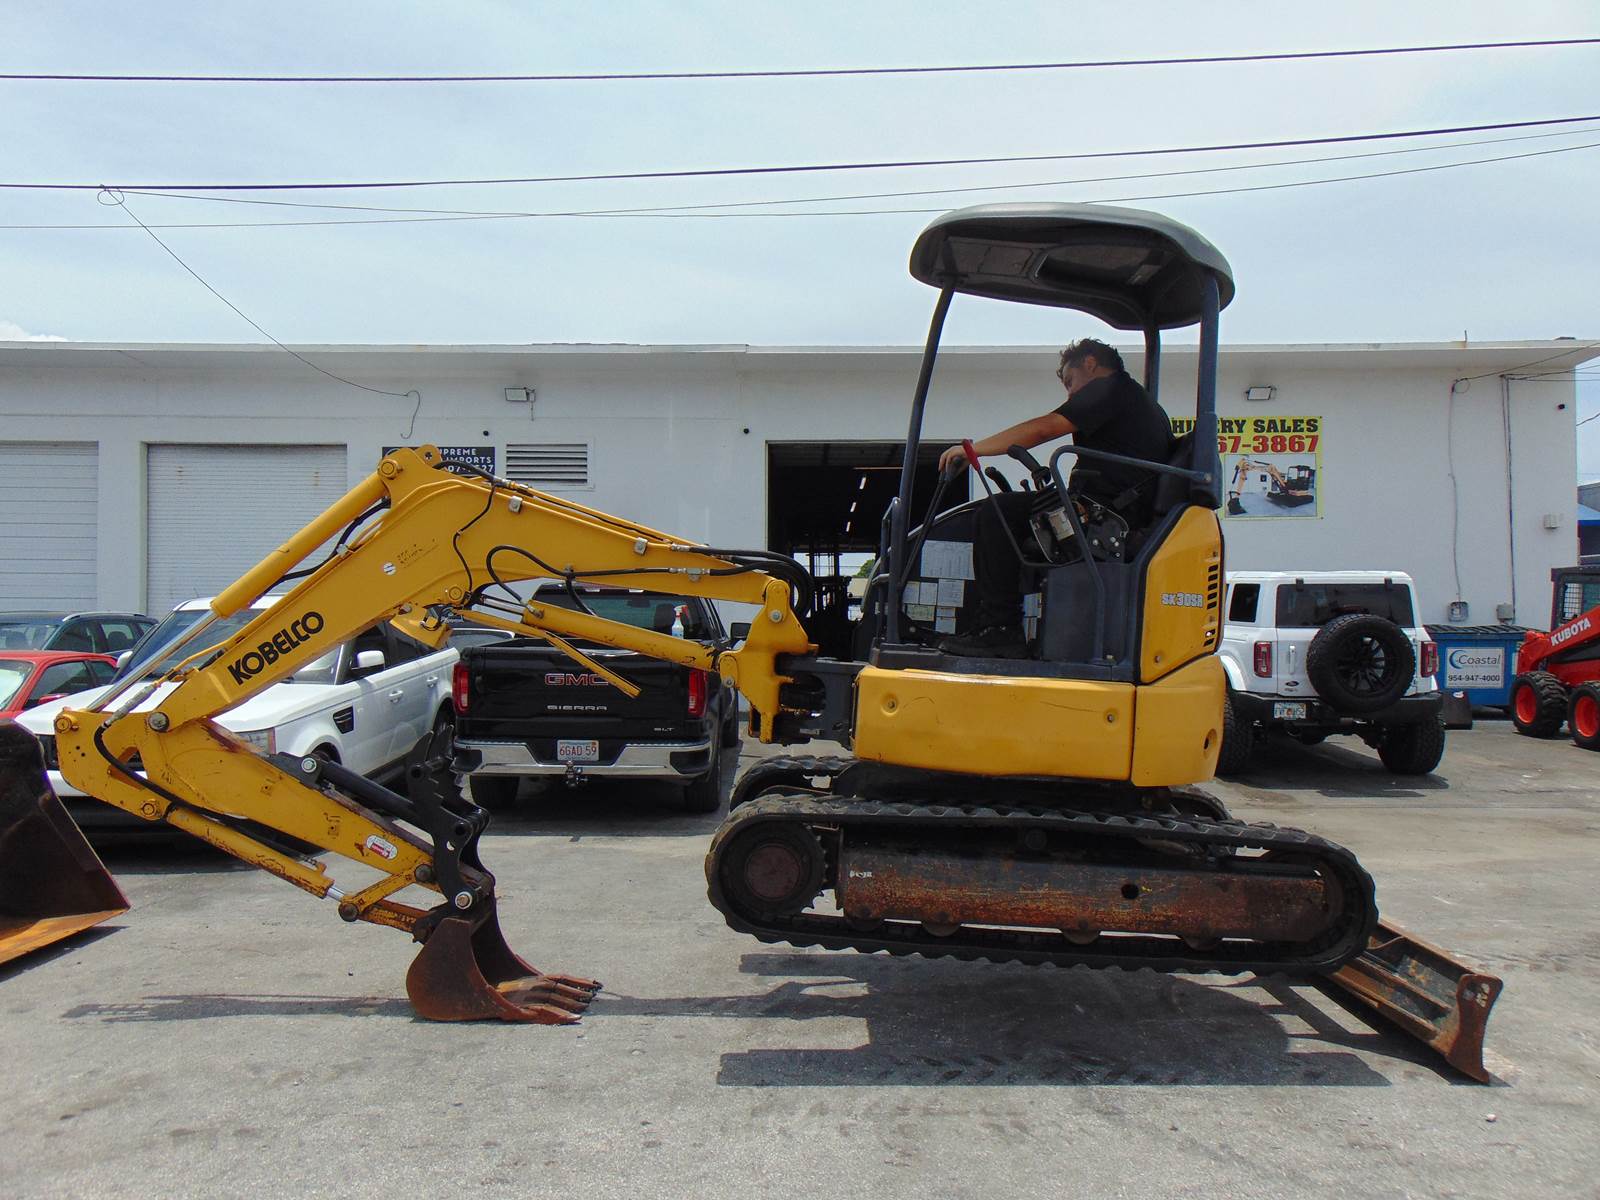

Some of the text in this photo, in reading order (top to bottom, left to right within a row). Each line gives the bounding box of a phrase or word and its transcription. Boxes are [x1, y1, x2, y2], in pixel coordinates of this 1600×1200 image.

[1253, 418, 1319, 433] SALES
[1550, 617, 1592, 647] KUBOTA
[227, 611, 324, 686] KOBELCO
[1458, 654, 1501, 665] Coastal
[544, 673, 609, 686] GMC
